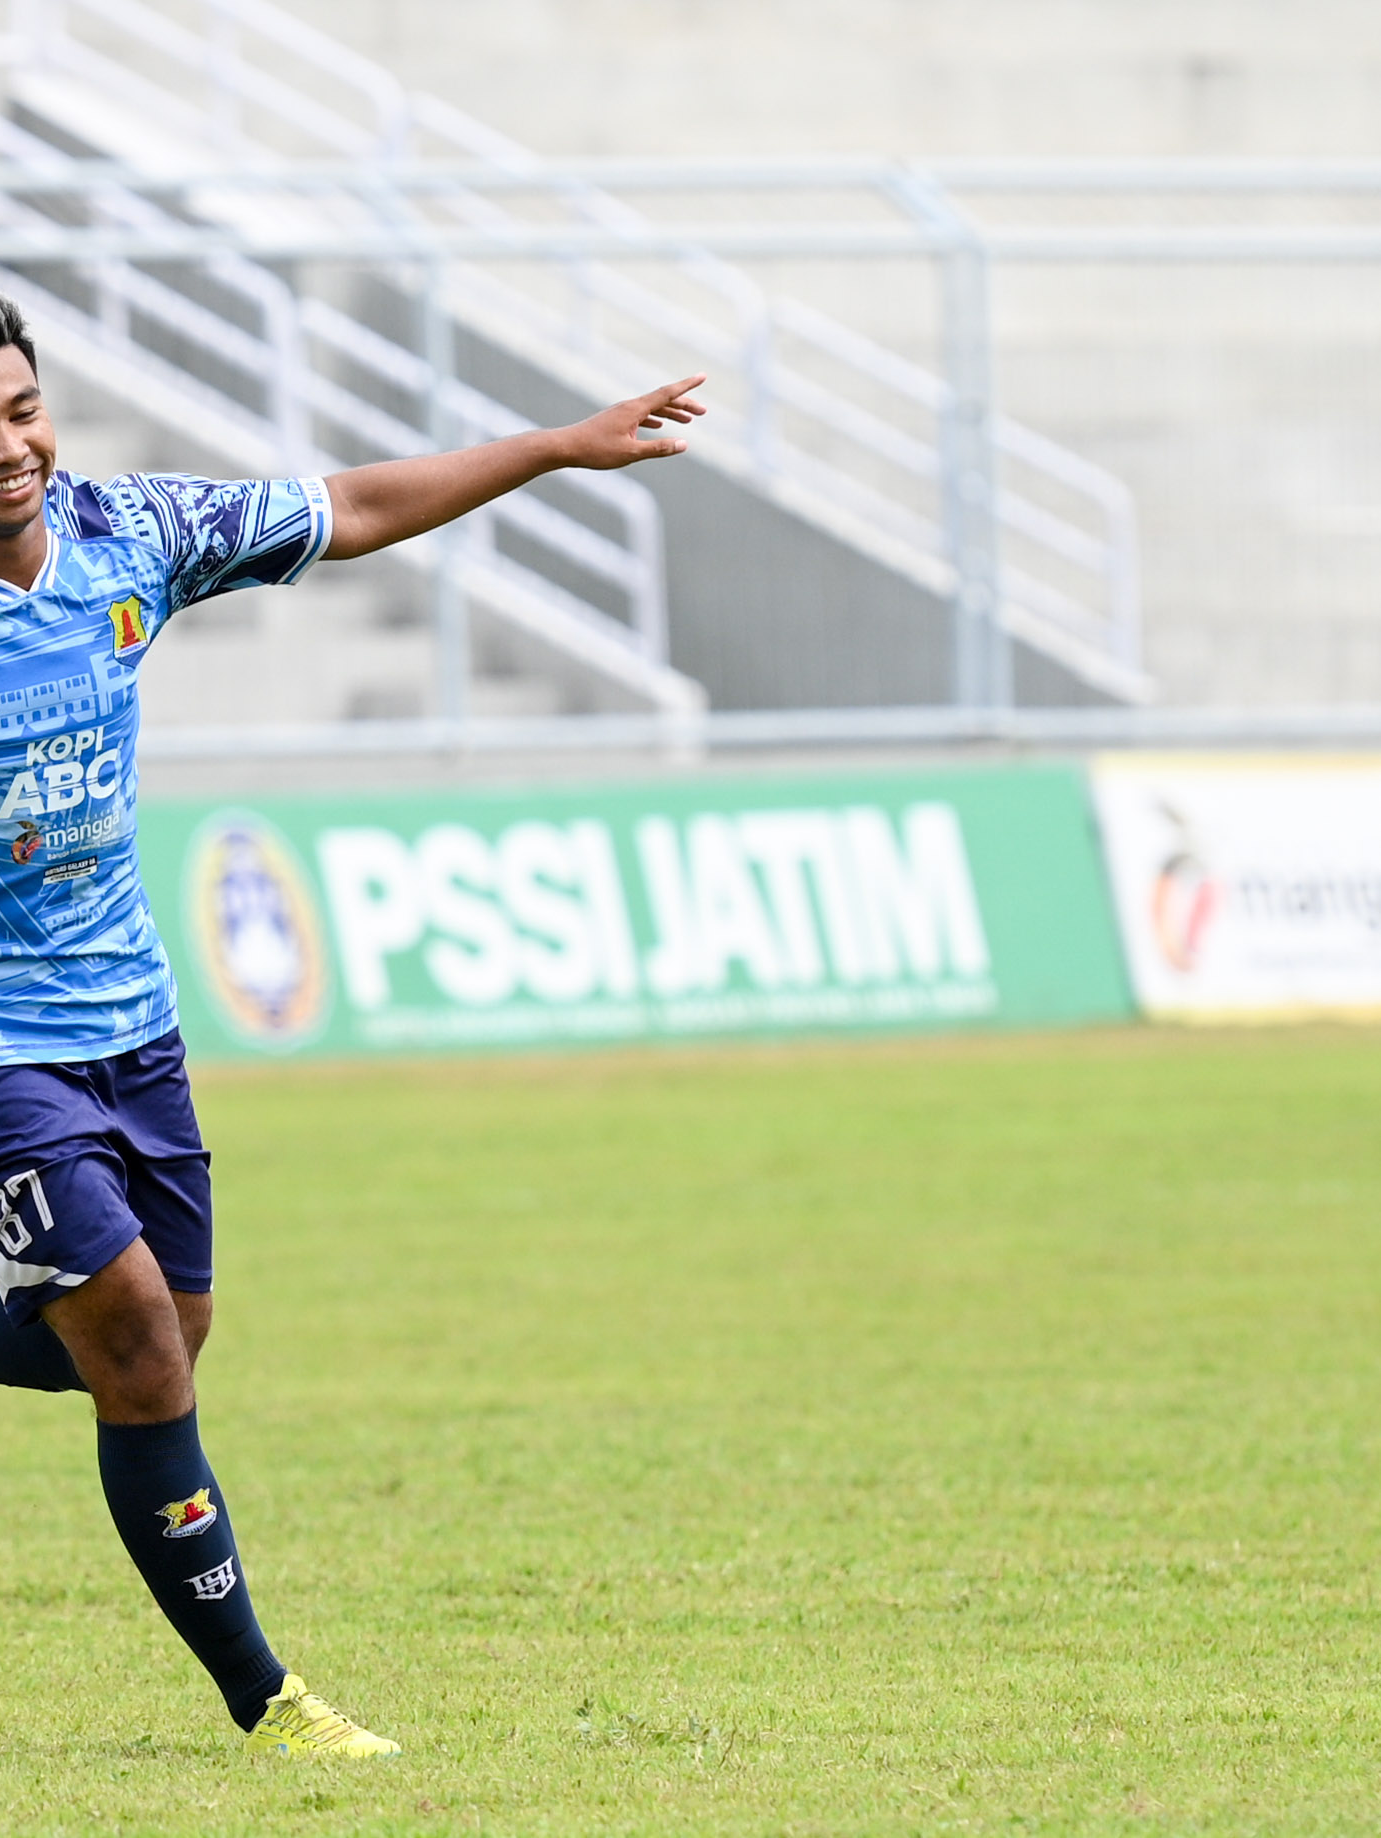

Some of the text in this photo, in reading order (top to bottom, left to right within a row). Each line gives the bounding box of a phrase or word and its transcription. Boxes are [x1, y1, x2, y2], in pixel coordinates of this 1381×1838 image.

[26, 726, 104, 766] KOPI
[45, 810, 120, 848] mangga
[315, 801, 993, 1006] PSSI JATIM
